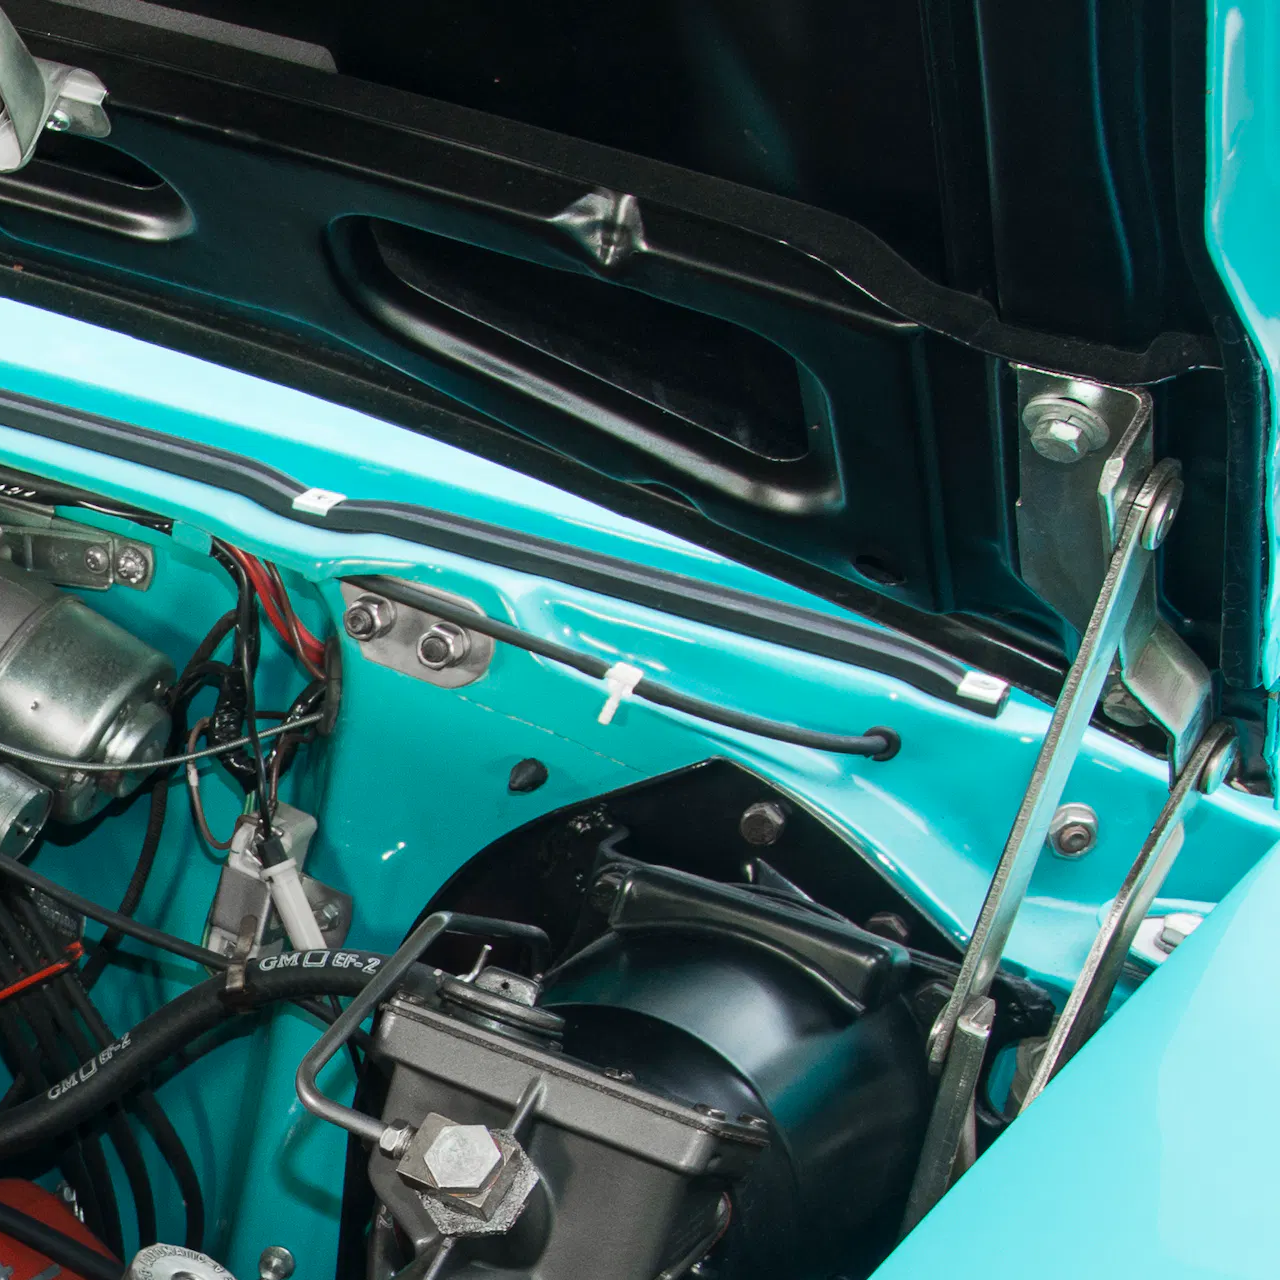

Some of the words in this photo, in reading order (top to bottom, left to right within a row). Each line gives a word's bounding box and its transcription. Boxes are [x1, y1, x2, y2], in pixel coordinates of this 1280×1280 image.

[259, 952, 302, 971] GM
[332, 952, 381, 975] EF-2
[48, 1072, 79, 1100] GM
[99, 1032, 132, 1065] EF-2
